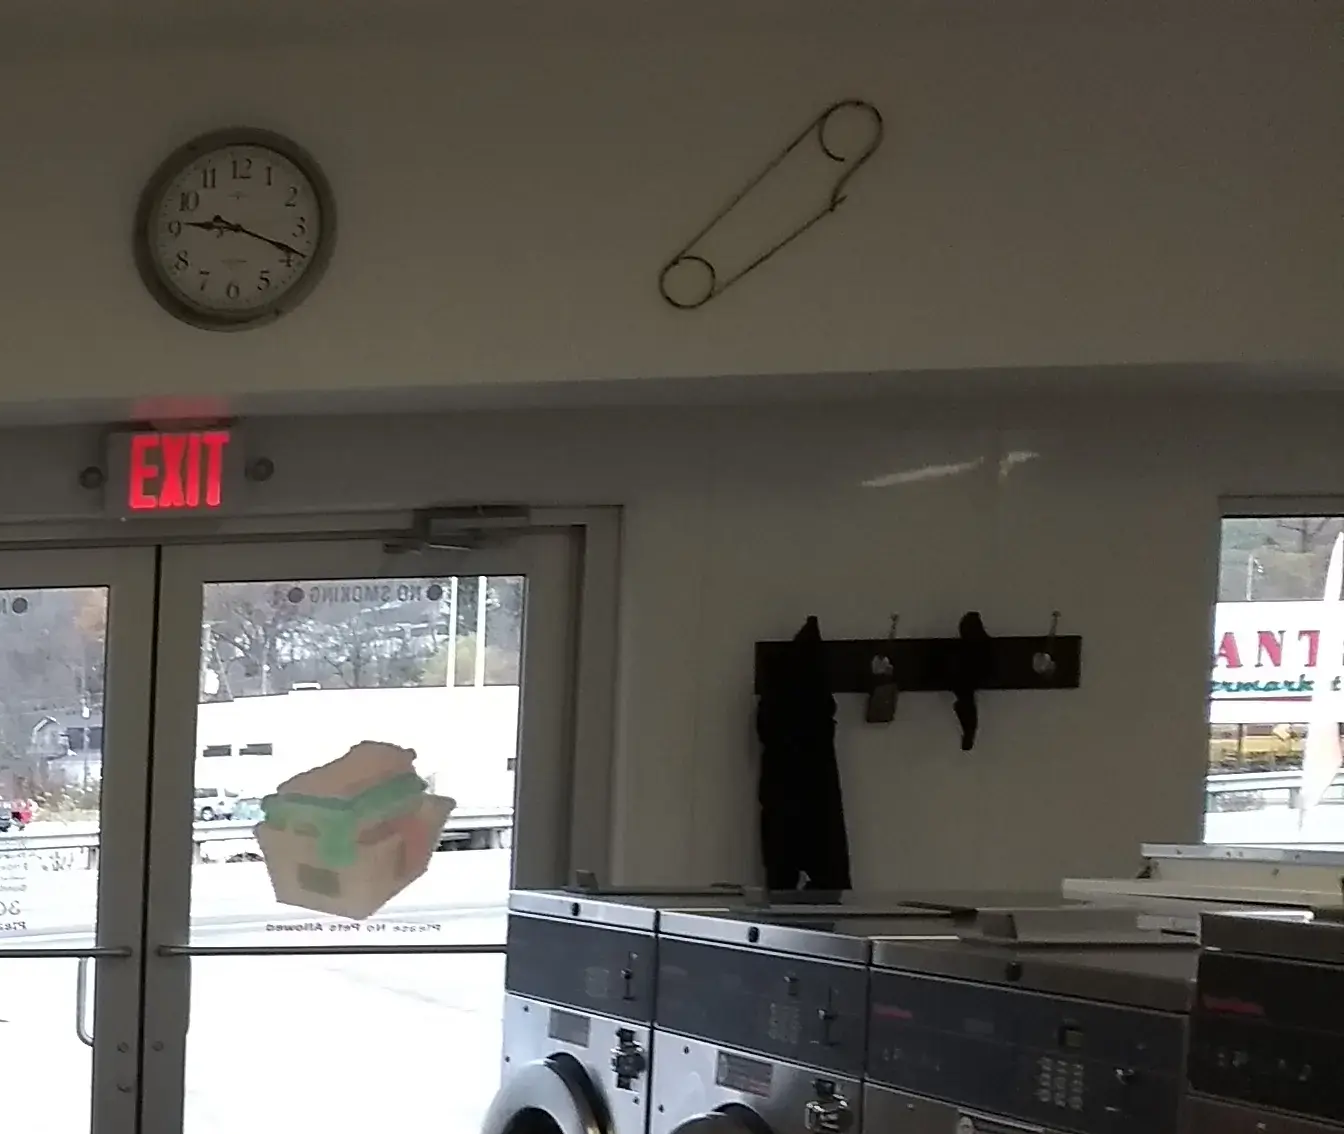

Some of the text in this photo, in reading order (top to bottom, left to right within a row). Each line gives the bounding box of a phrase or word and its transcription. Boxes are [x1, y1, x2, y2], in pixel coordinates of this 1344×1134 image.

[203, 168, 216, 188] 11
[232, 158, 252, 179] 12
[266, 166, 272, 186] 1
[178, 191, 200, 211] 10
[284, 186, 298, 207] 2
[168, 220, 182, 239] 9
[292, 216, 306, 238] 3
[174, 250, 189, 271] 8
[199, 270, 211, 291] 7
[257, 270, 270, 291] 5
[128, 431, 231, 510] EXIT
[1212, 629, 1344, 669] ANT
